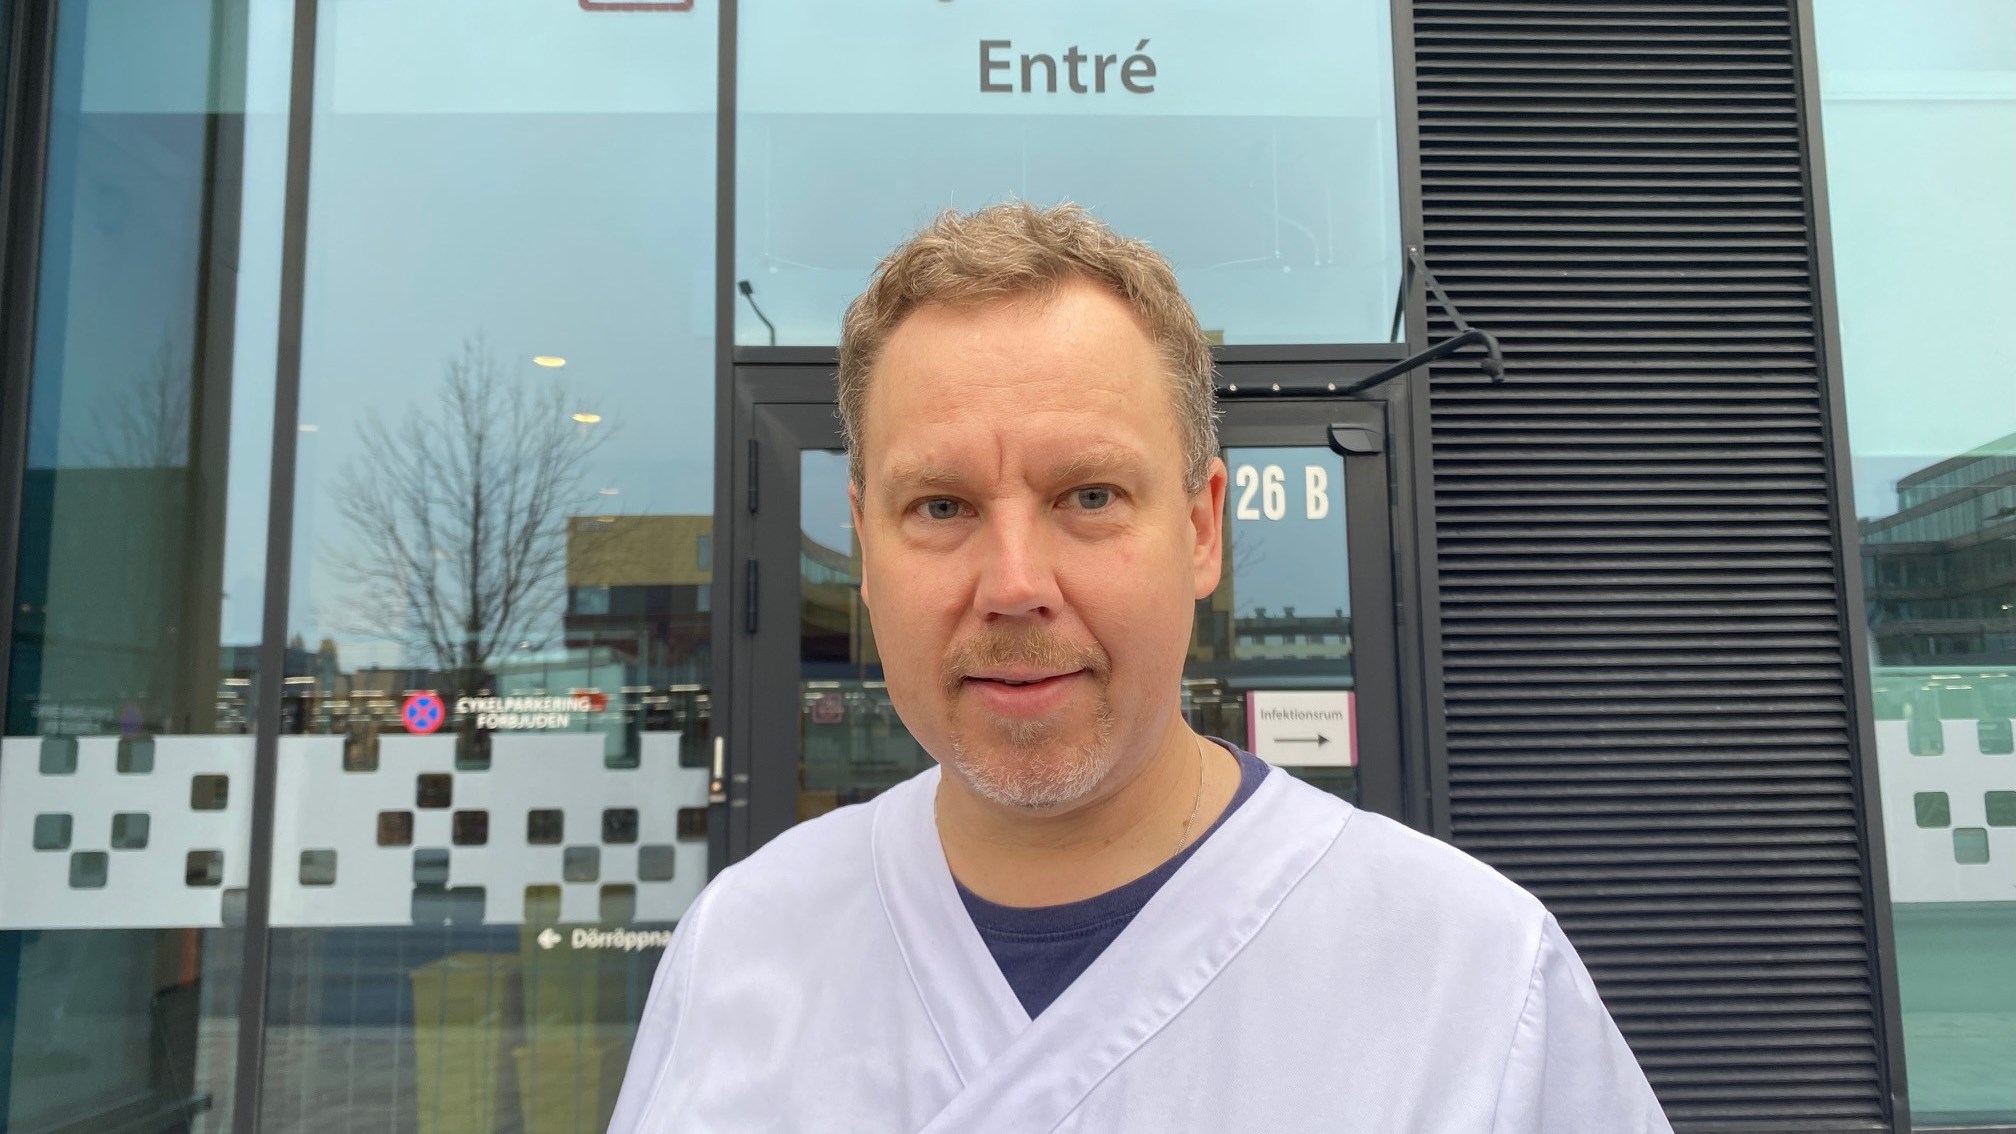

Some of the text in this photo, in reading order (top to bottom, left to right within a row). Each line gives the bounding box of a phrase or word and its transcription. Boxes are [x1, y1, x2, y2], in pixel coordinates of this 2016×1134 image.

[978, 38, 1157, 94] Entré
[1236, 465, 1329, 520] 26 B
[457, 697, 591, 713] CYKELPARKERING
[1260, 708, 1343, 720] Infektionsrum
